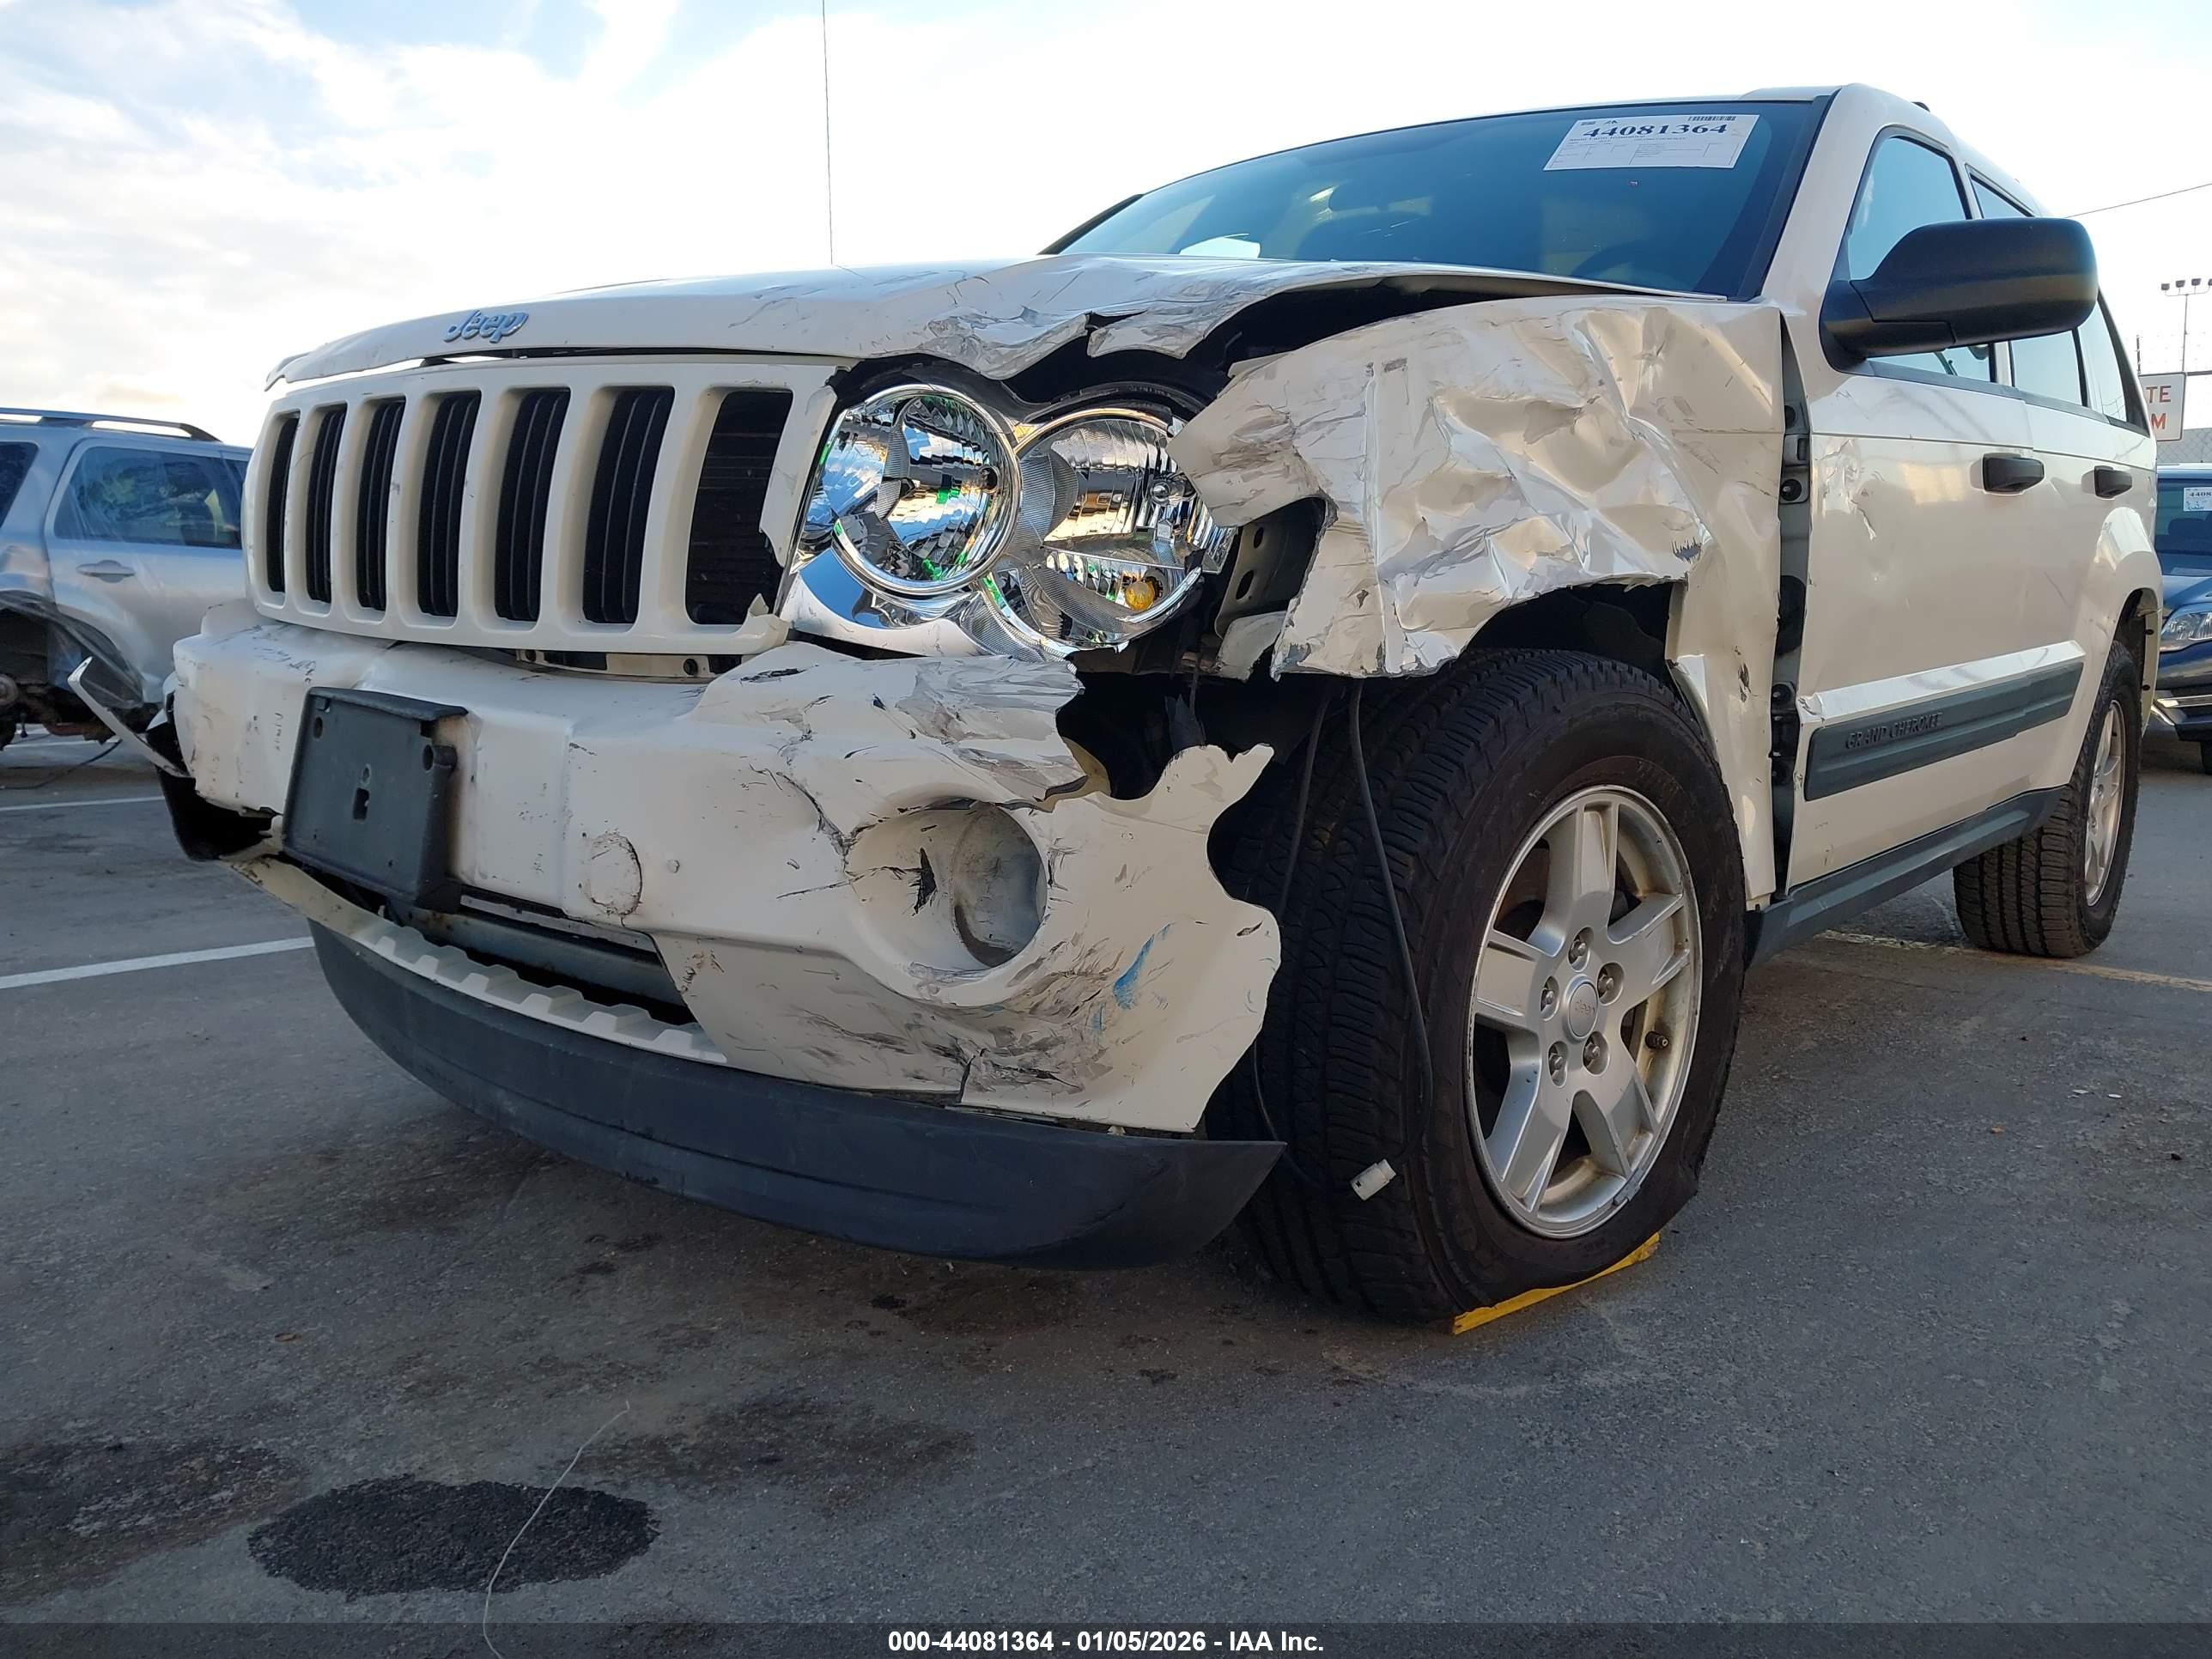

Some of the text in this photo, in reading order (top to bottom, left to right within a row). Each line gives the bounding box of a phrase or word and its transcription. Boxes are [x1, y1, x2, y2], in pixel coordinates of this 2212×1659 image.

[1583, 124, 1728, 137] 44081364
[443, 309, 529, 343] Jeep
[2146, 385, 2172, 404] TE
[2150, 412, 2166, 429] M
